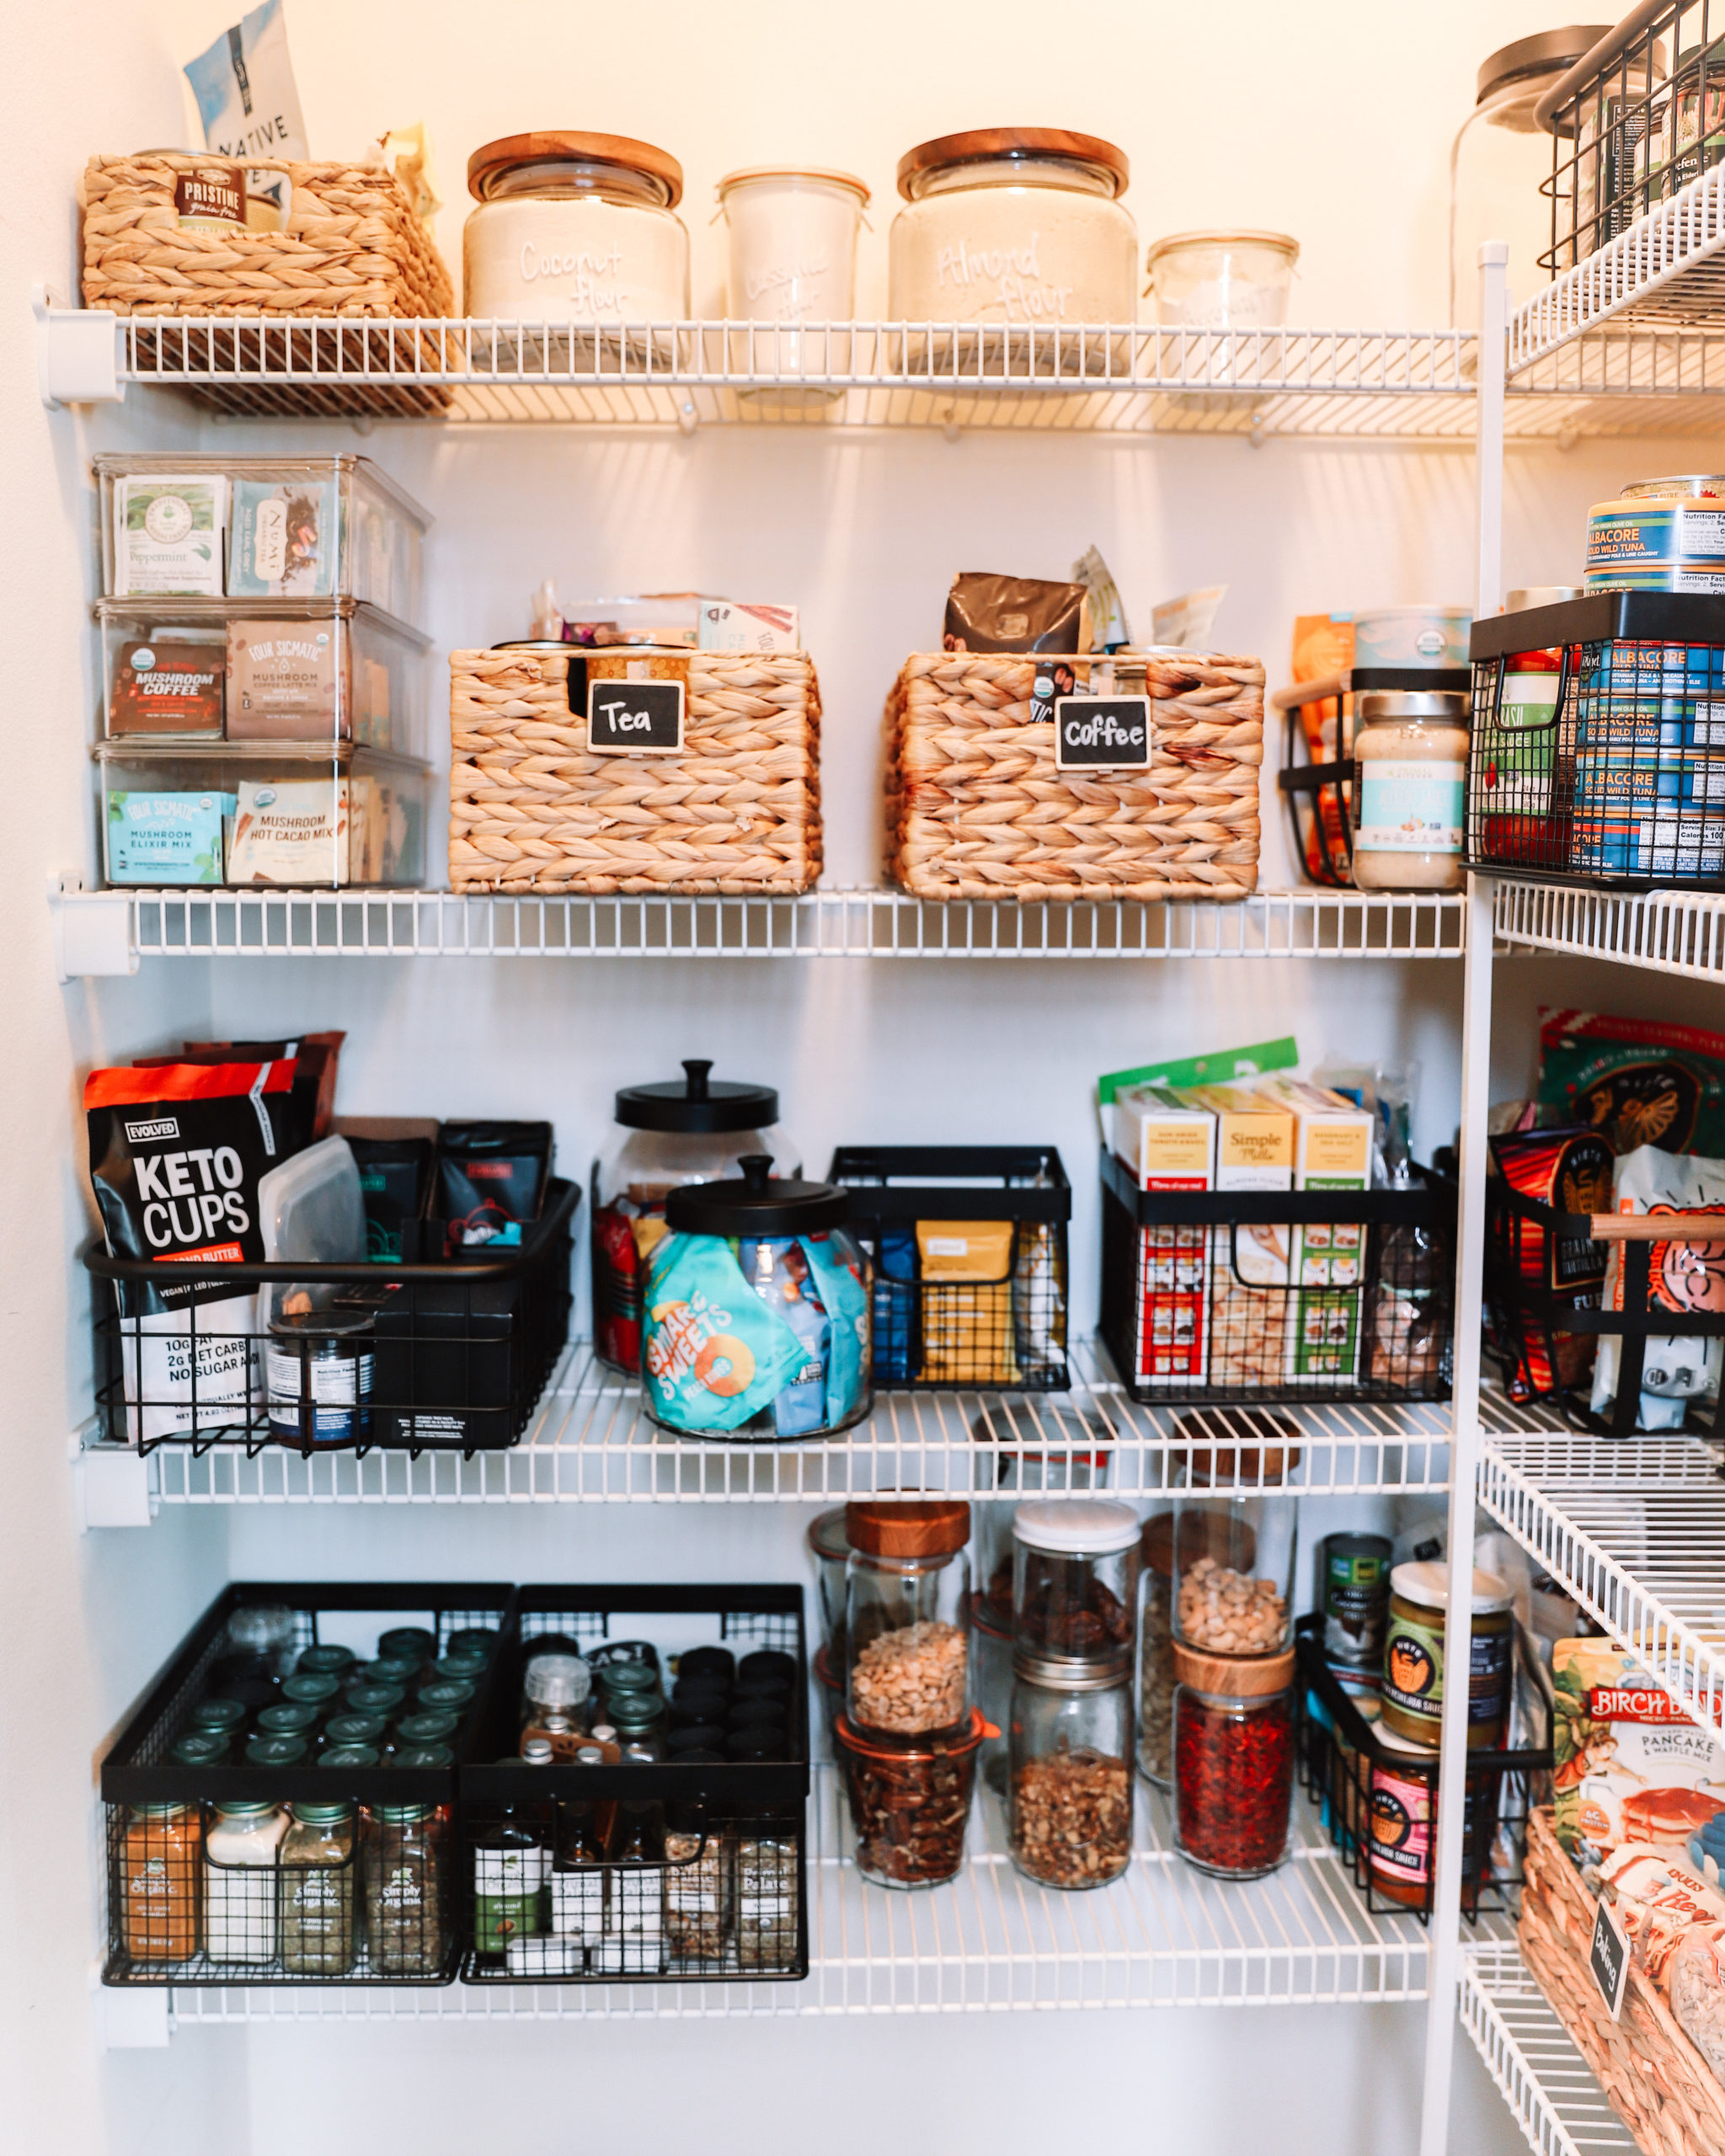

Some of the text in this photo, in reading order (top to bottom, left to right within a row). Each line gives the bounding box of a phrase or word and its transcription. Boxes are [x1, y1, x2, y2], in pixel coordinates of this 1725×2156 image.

[219, 115, 288, 158] NATIVE
[1674, 153, 1708, 171] efene
[184, 181, 239, 210] PRISTINE
[519, 241, 622, 280] Coconut
[937, 232, 1040, 287] Almond
[1589, 527, 1640, 544] ALBACORE
[1600, 544, 1619, 554] WILD
[1620, 542, 1646, 552] TUNA
[129, 552, 187, 565] Peppermint
[1612, 650, 1686, 664] ALBACORE
[136, 672, 215, 686] MUSHROOM
[253, 673, 318, 681] MUSHROOM
[142, 683, 200, 696] COFFEE
[599, 701, 652, 733] Tea
[1589, 712, 1655, 727] ABACORE
[1065, 713, 1145, 747] Coffee
[1587, 728, 1607, 737] SOID
[1608, 728, 1631, 737] WILD
[1585, 771, 1654, 786] ABACORE
[260, 814, 326, 829] MUSHROOM
[131, 830, 192, 839] MUSHROOM
[250, 828, 334, 841] HOT CACAO MIX
[130, 1123, 175, 1138] EVOLVED
[1231, 1132, 1282, 1147] Simple
[133, 1145, 243, 1202] KETO
[143, 1190, 250, 1248] CUPS
[203, 1247, 240, 1262] BUTTER
[160, 1281, 207, 1298] VEGAN PLEO
[658, 1302, 733, 1401] SWEETS
[168, 1354, 185, 1367] 2G
[169, 1358, 239, 1382] NO SUGAR
[1592, 1690, 1666, 1716] BIRCH
[1642, 1734, 1715, 1753] PANCAKE
[1653, 1746, 1689, 1755] WAFFLE
[1694, 1752, 1712, 1763] MIX
[1594, 1920, 1616, 1993] Baking
